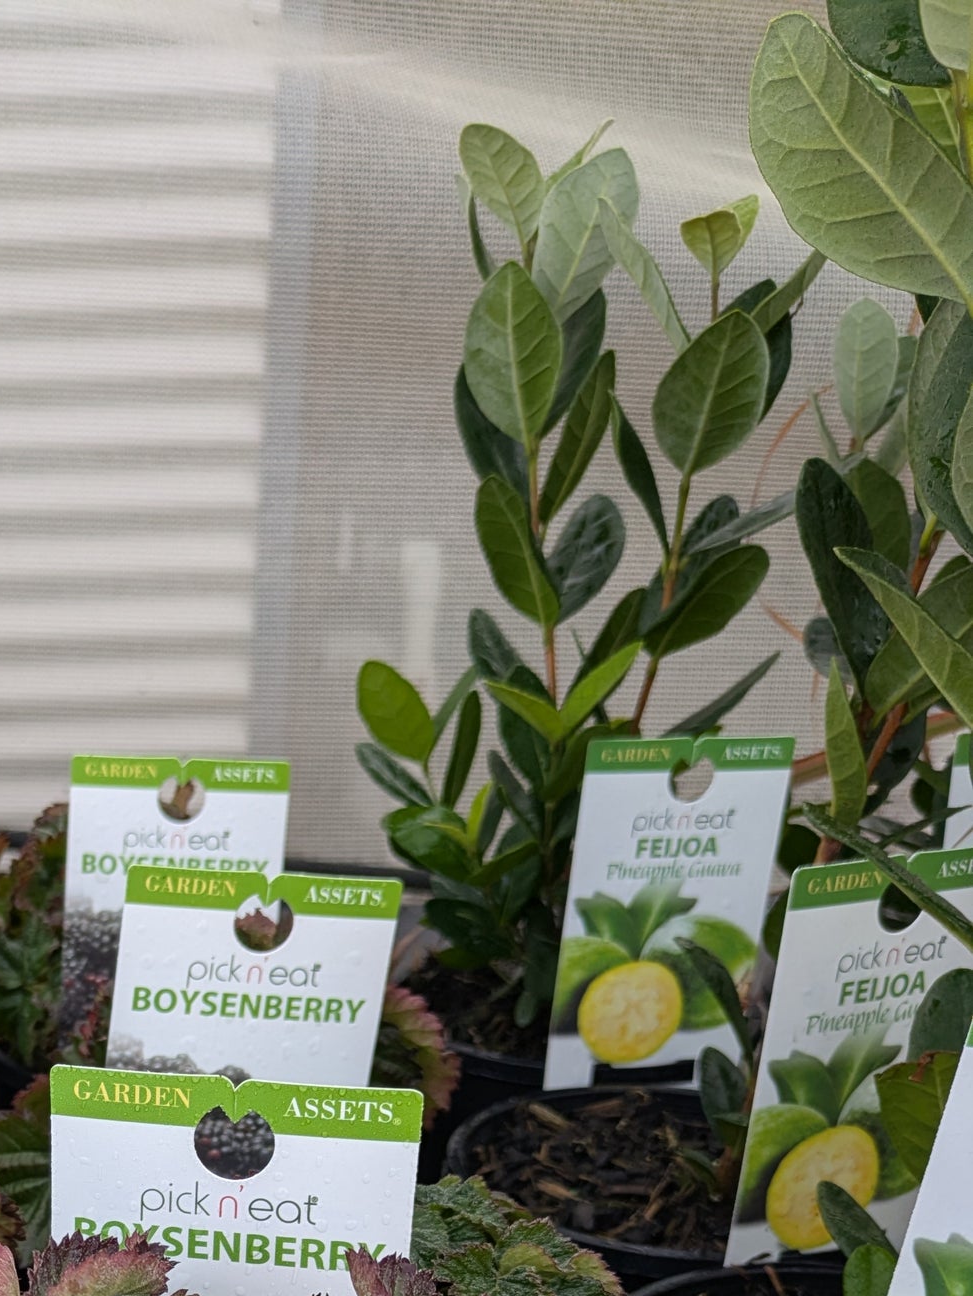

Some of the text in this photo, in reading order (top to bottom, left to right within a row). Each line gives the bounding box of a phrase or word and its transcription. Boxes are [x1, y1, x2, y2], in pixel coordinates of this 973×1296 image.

[601, 745, 783, 763] GARDEN ASSETS
[85, 763, 276, 784] GARDEN ASSETS
[123, 824, 167, 857] pick
[635, 836, 718, 859] FEIJOA
[606, 861, 742, 885] Pineapple Guava
[807, 870, 885, 895] GARDEN
[145, 874, 382, 907] GARDEN ASSETS
[186, 954, 241, 988] pick
[835, 941, 886, 983] pick
[838, 970, 926, 1007] FEIJOA
[131, 986, 367, 1025] BOYSENBERRY
[806, 1001, 891, 1037] Pineapple
[73, 1079, 394, 1124] GARDEN ASSETS
[139, 1181, 211, 1221] pick
[248, 1194, 318, 1226] eat
